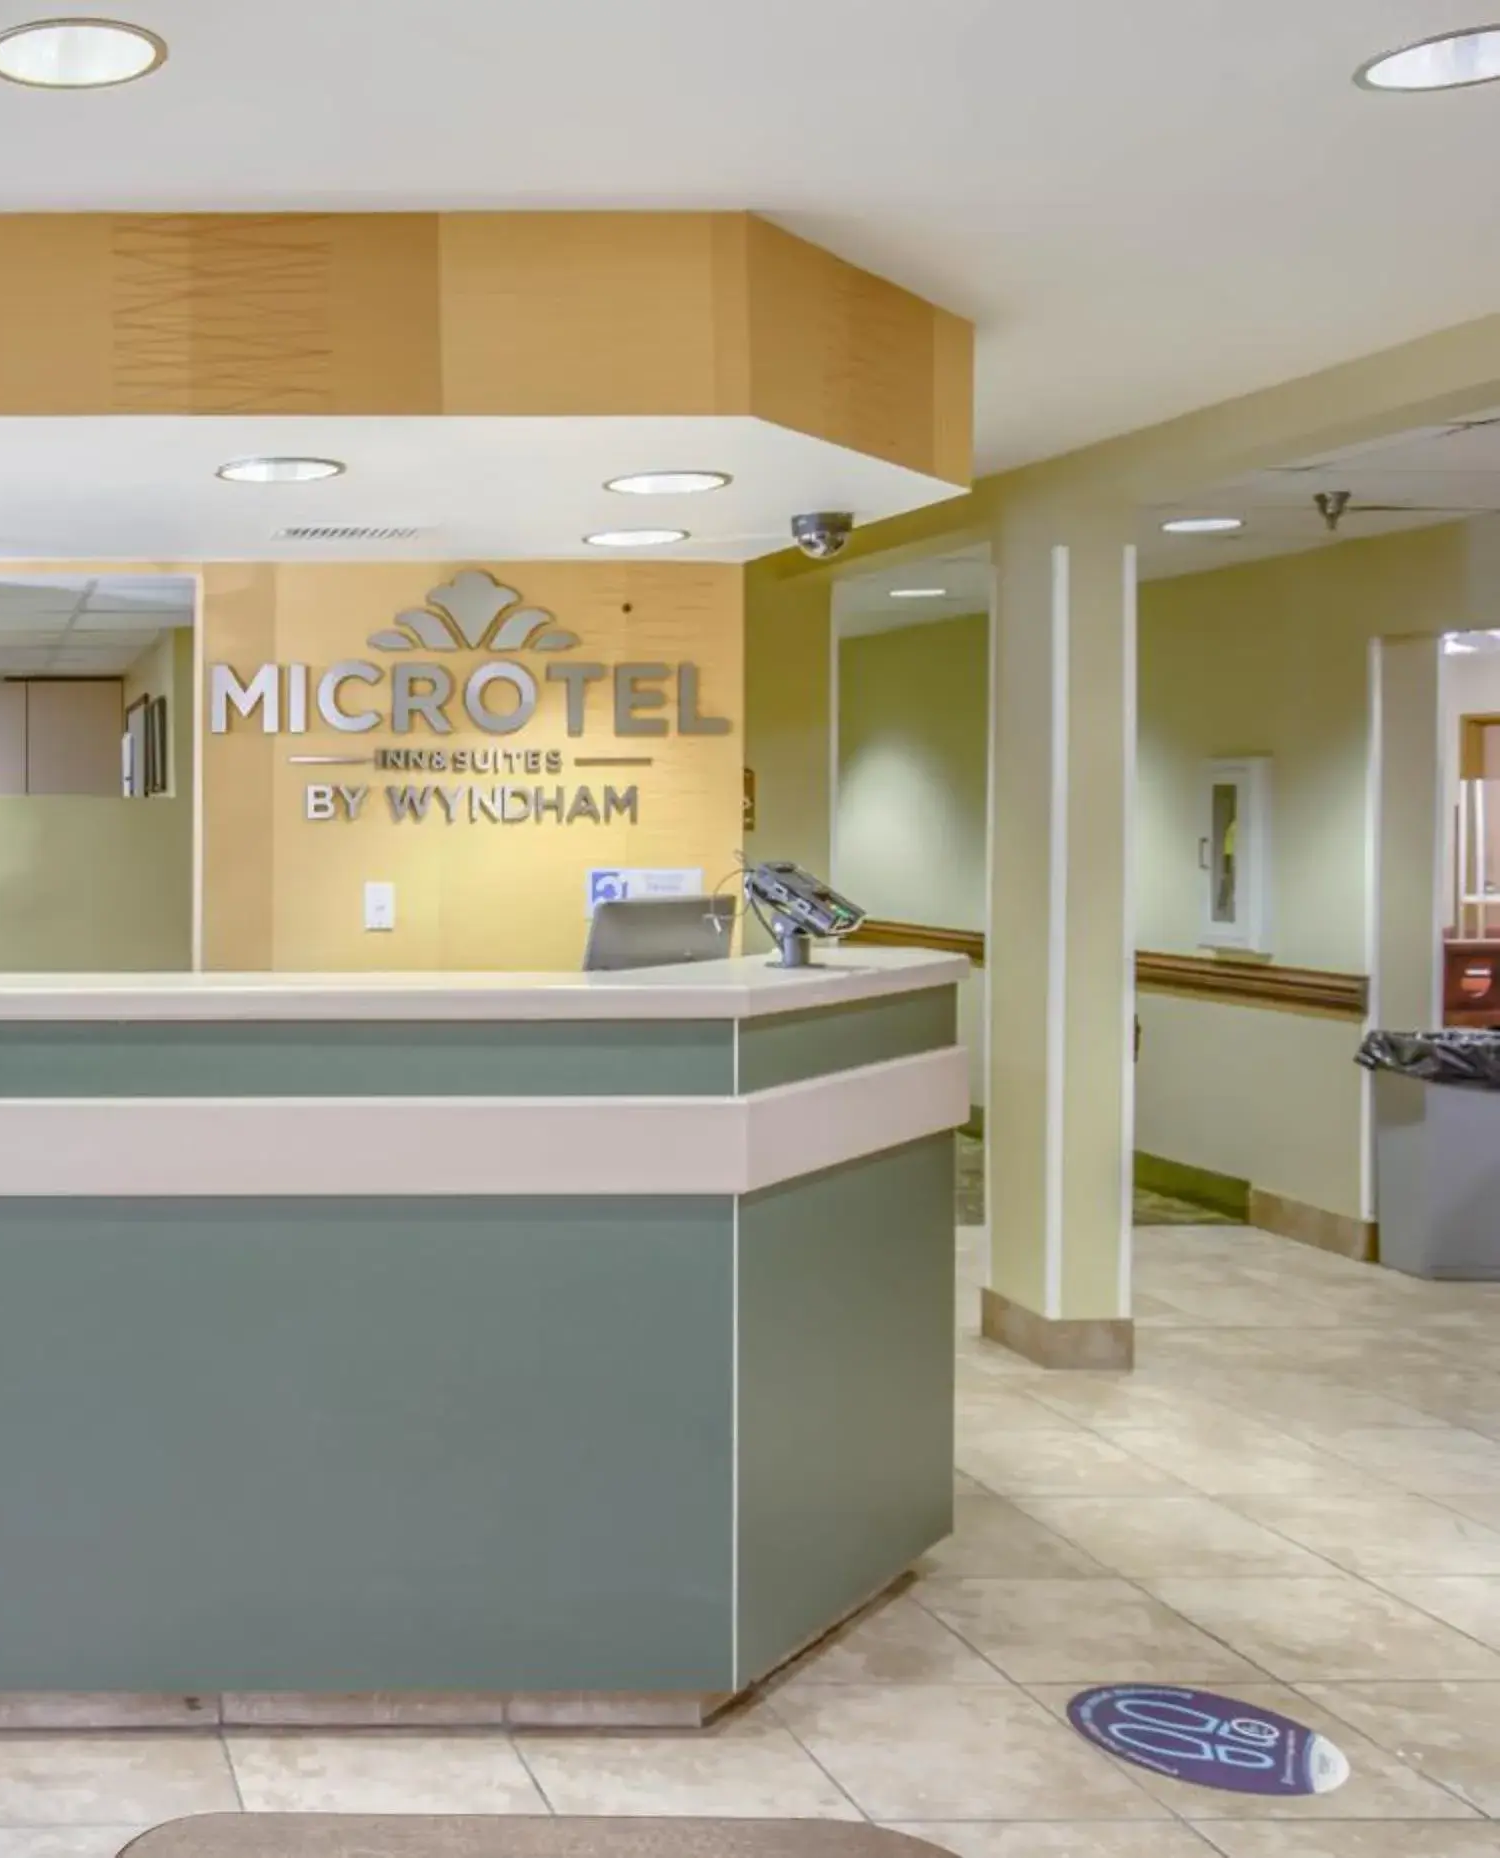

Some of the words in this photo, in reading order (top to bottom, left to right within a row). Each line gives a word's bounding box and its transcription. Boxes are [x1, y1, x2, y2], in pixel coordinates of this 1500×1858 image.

[209, 659, 733, 738] MICROTEL
[306, 784, 368, 823] BY
[384, 784, 639, 826] WYNDHAM
